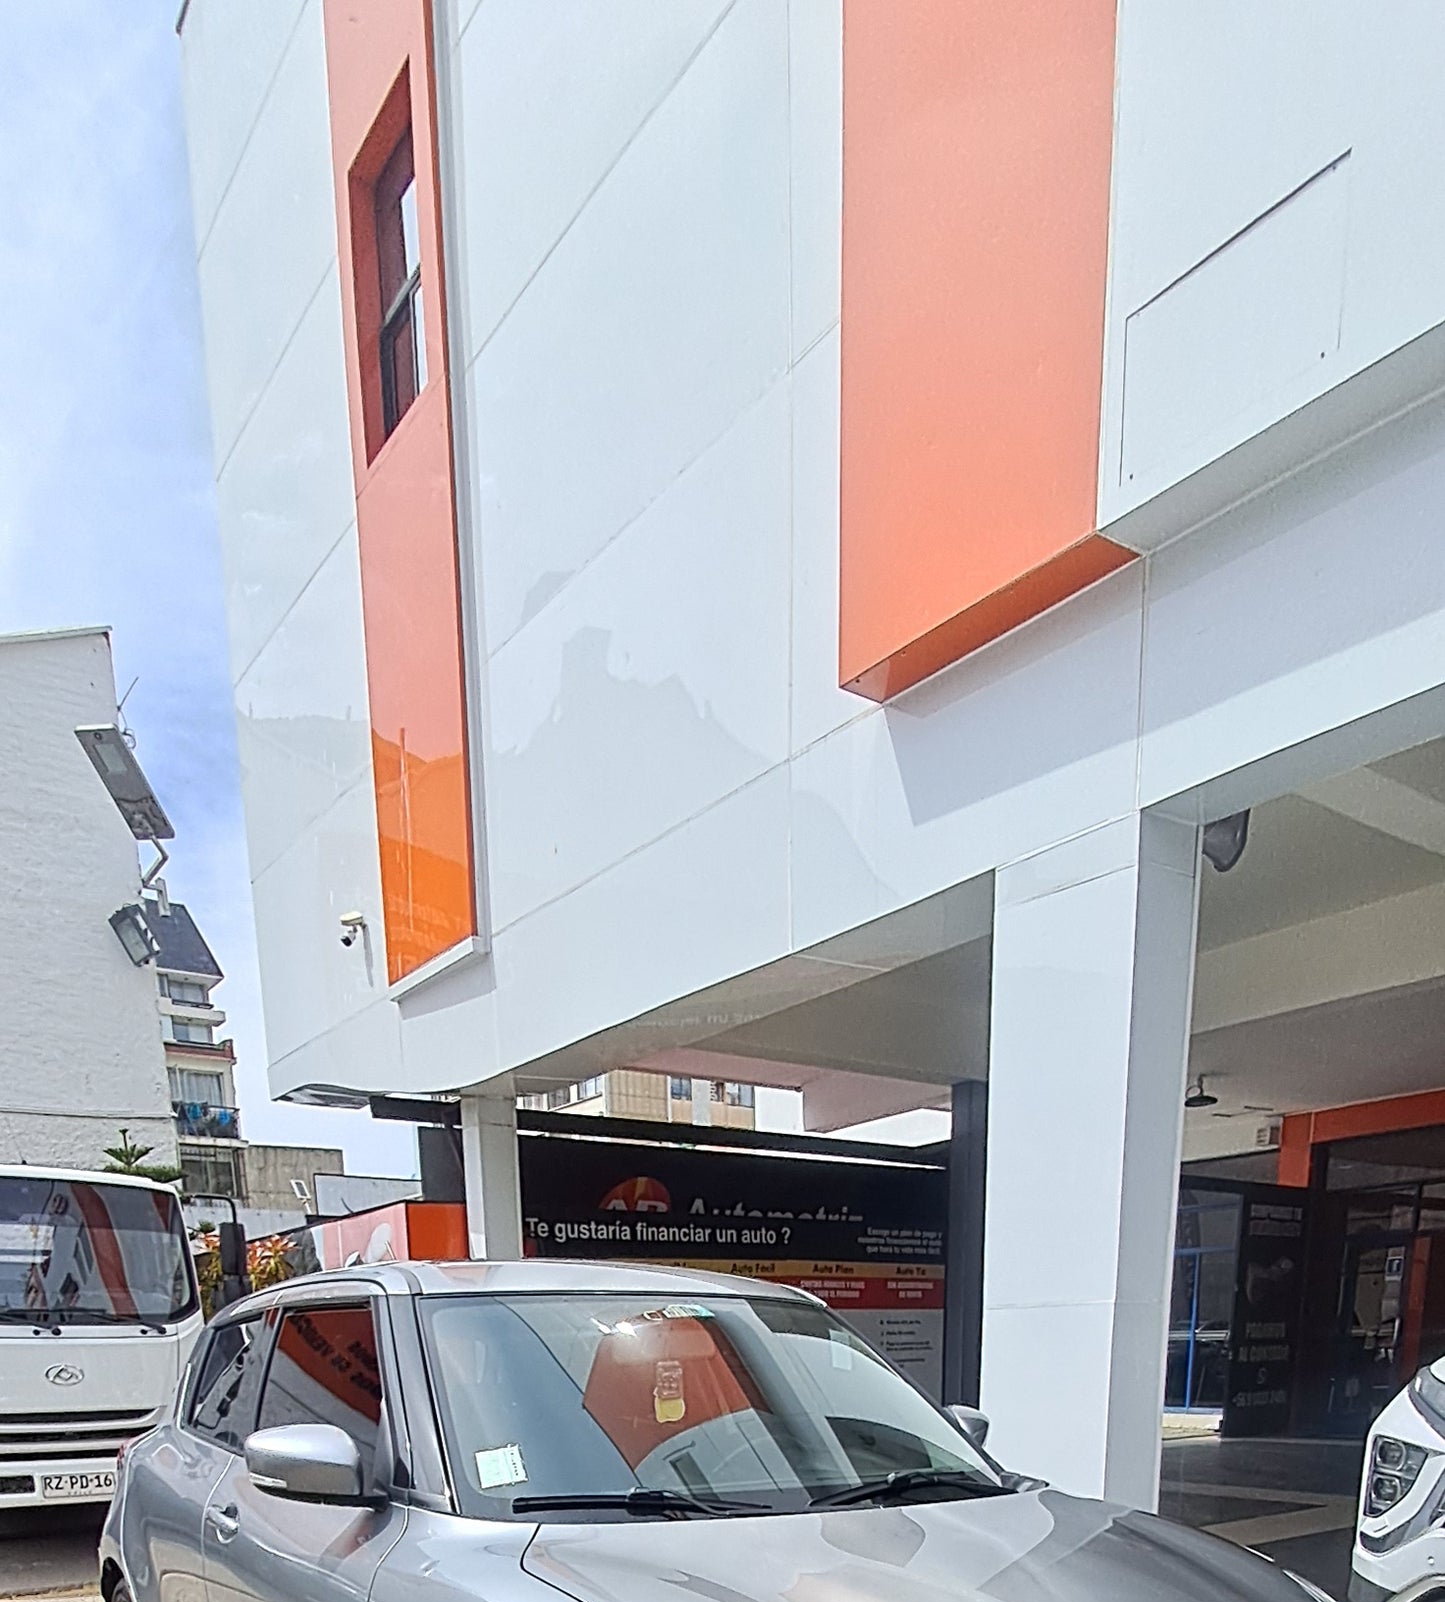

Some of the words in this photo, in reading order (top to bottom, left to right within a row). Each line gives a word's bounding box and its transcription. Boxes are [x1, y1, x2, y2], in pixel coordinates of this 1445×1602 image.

[525, 1218, 549, 1237] Te
[554, 1220, 631, 1244] gustaría
[636, 1221, 712, 1243] financiar
[716, 1229, 737, 1243] un
[741, 1229, 777, 1244] auto
[781, 1227, 791, 1245] ?
